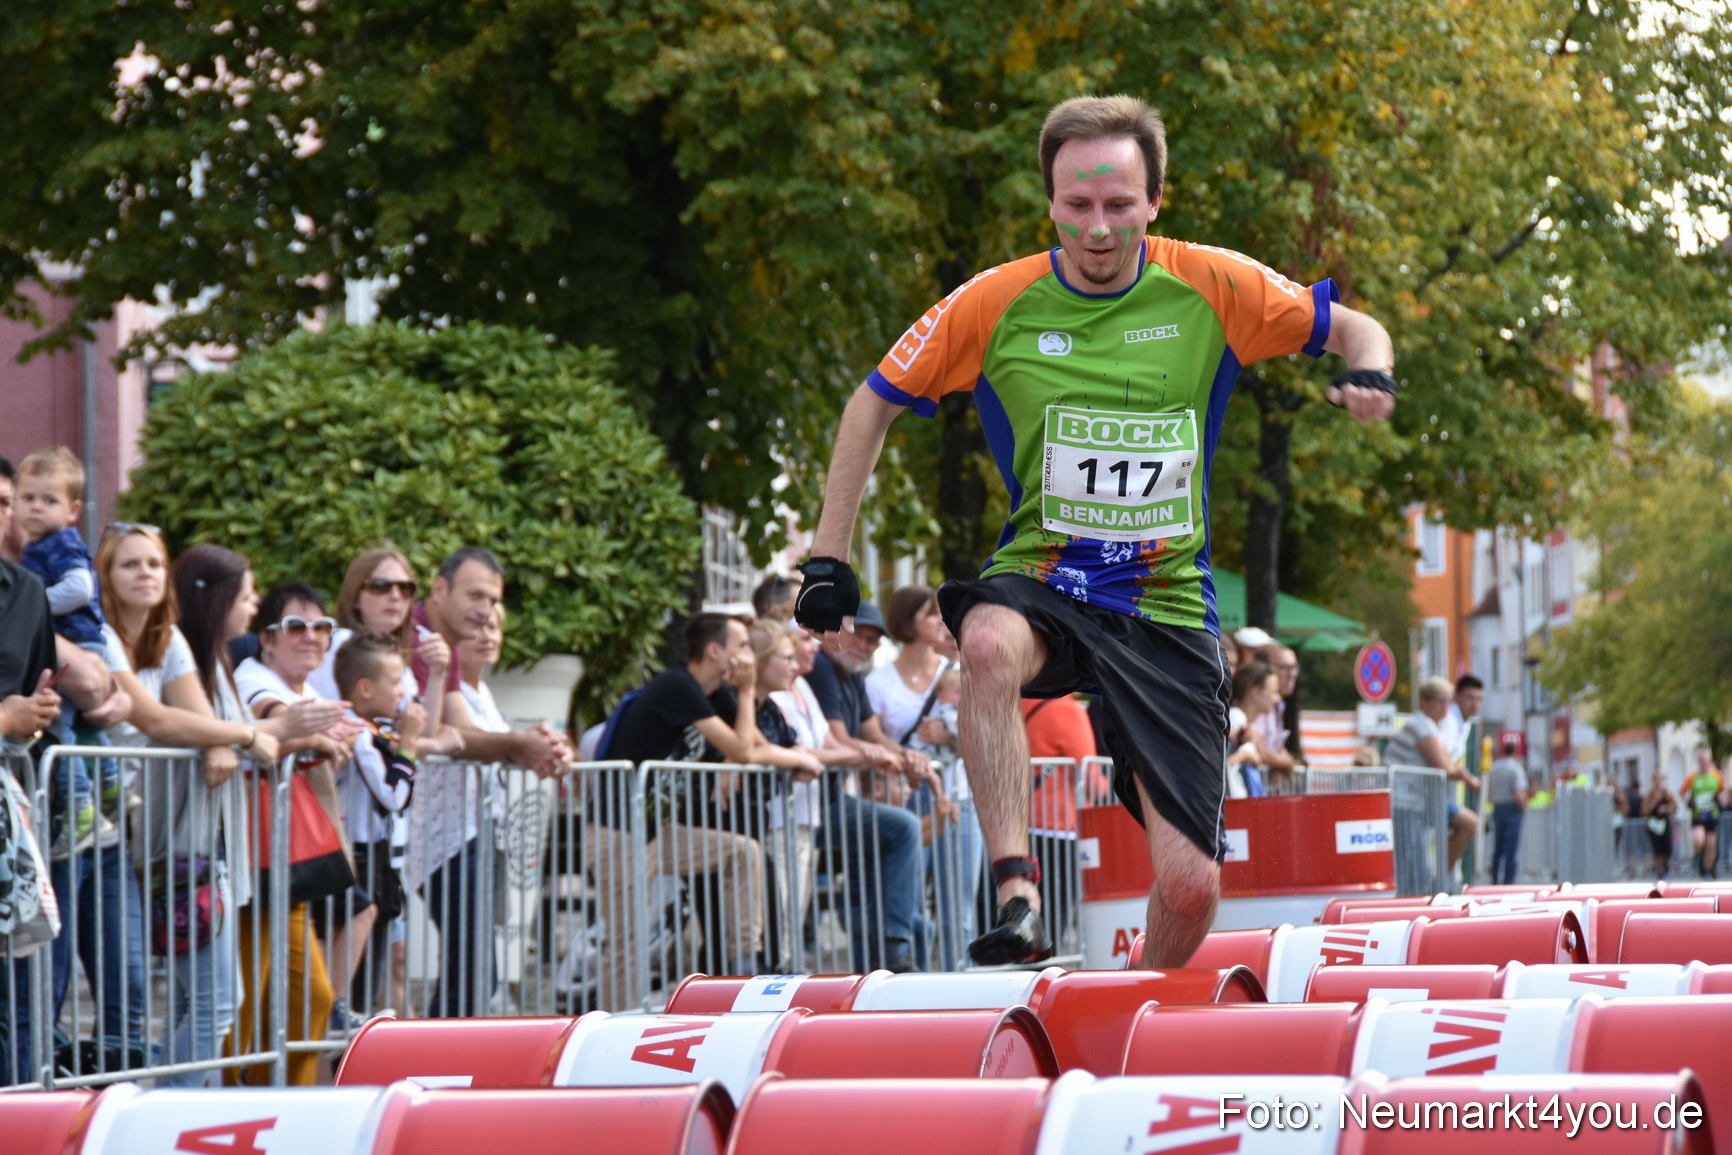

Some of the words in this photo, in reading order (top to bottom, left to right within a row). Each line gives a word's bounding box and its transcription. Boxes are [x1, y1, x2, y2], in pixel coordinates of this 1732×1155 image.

[1124, 324, 1180, 343] BOCK
[1056, 412, 1184, 448] BOCK
[1077, 458, 1163, 497] 117
[1060, 503, 1174, 527] BENJAMIN
